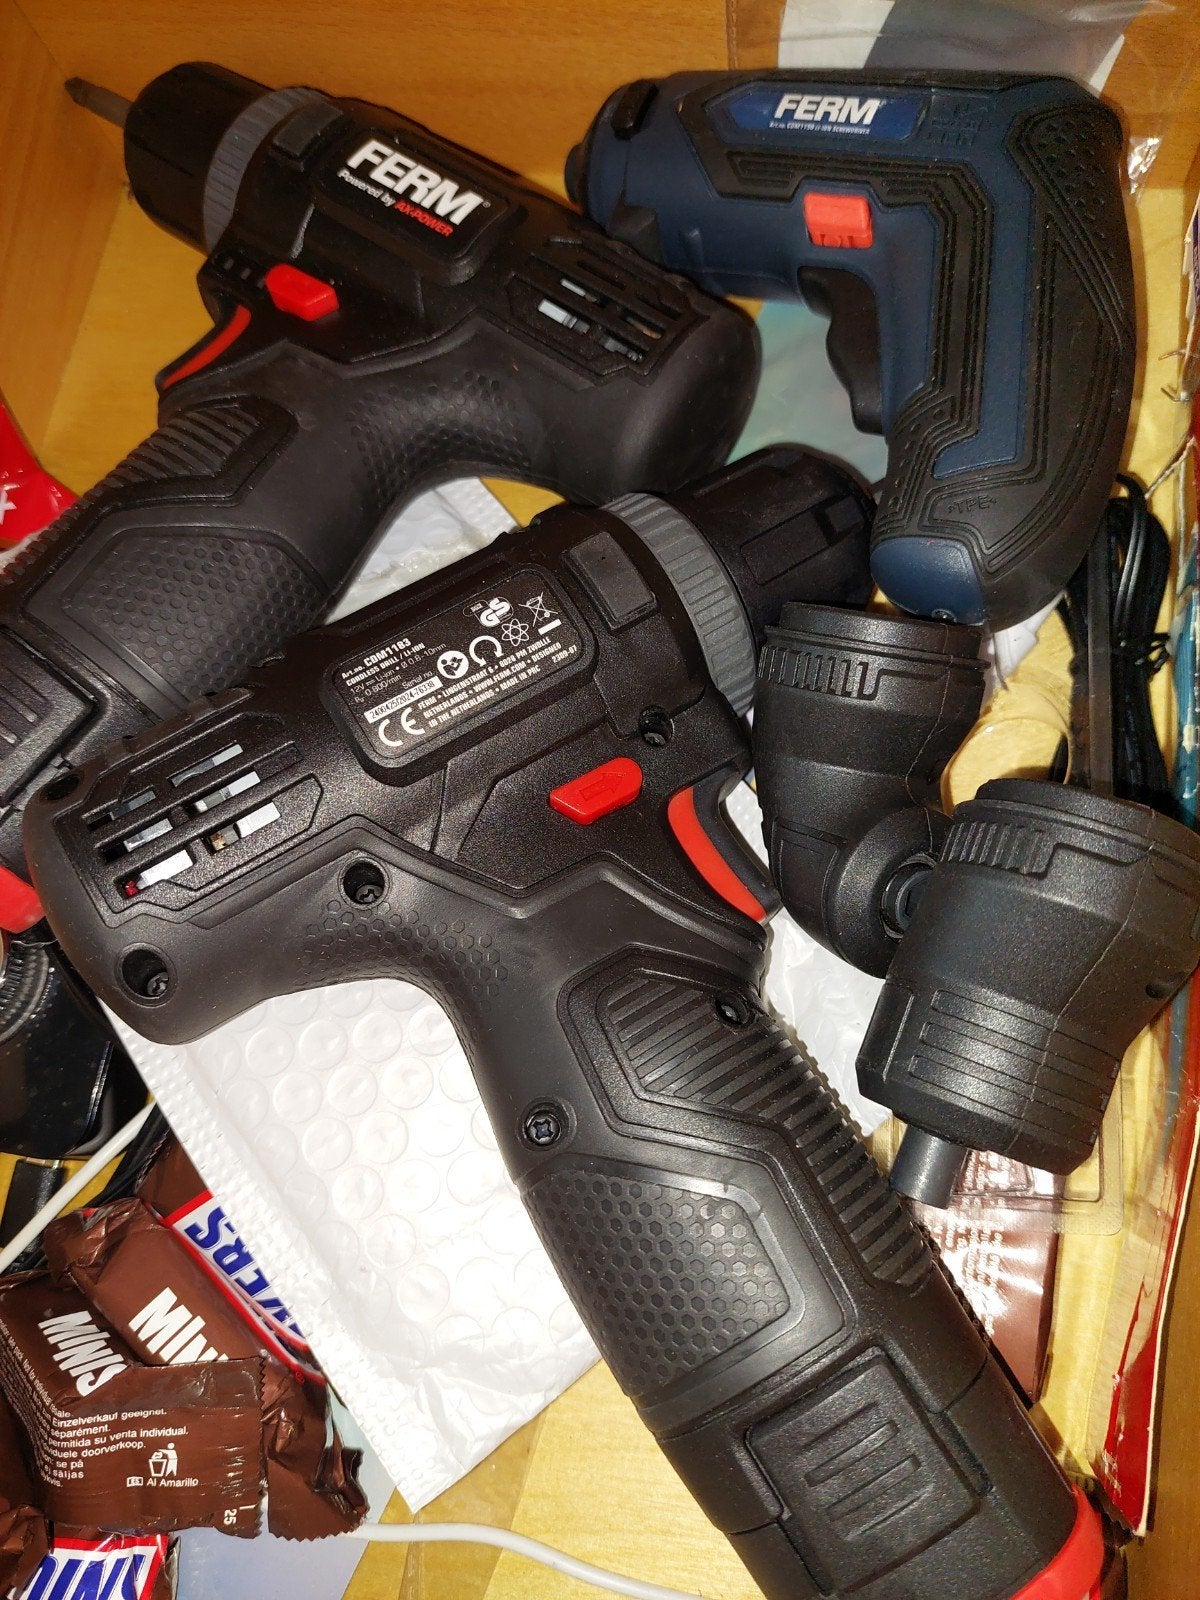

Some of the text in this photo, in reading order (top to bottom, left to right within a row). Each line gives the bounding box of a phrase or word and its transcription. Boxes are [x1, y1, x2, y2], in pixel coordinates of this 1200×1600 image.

[774, 93, 880, 125] FERM
[337, 169, 384, 199] Powered
[381, 188, 397, 207] by
[347, 139, 484, 225] FERM
[340, 637, 411, 679] Art.no. CDM1183
[345, 664, 380, 686] CORDLESS
[379, 655, 398, 669] DRILL
[402, 641, 425, 657] LI-ION
[401, 674, 423, 689] Serial
[417, 695, 437, 710] FERM
[441, 668, 488, 697] LINGENSTRAAT
[526, 635, 552, 653] ZWOLLE
[422, 641, 562, 718] NETHERLANDS WWW.FERM.COM DESIGNED
[349, 683, 365, 694] 12V
[437, 711, 451, 723] THE
[449, 687, 495, 716] NETHERLANDS
[499, 675, 519, 691] MADE
[37, 1310, 132, 1397] MINIS
[52, 1411, 118, 1427] Einzelverkauf
[94, 1436, 107, 1445] su
[110, 1430, 137, 1441] venta
[140, 1425, 188, 1438] individual.
[81, 1441, 146, 1458] doorverkoop.
[53, 1470, 84, 1479] säljas
[56, 1460, 67, 1468] se
[147, 1477, 157, 1487] Al
[159, 1477, 199, 1488] Amarillo
[223, 1508, 237, 1525] 25
